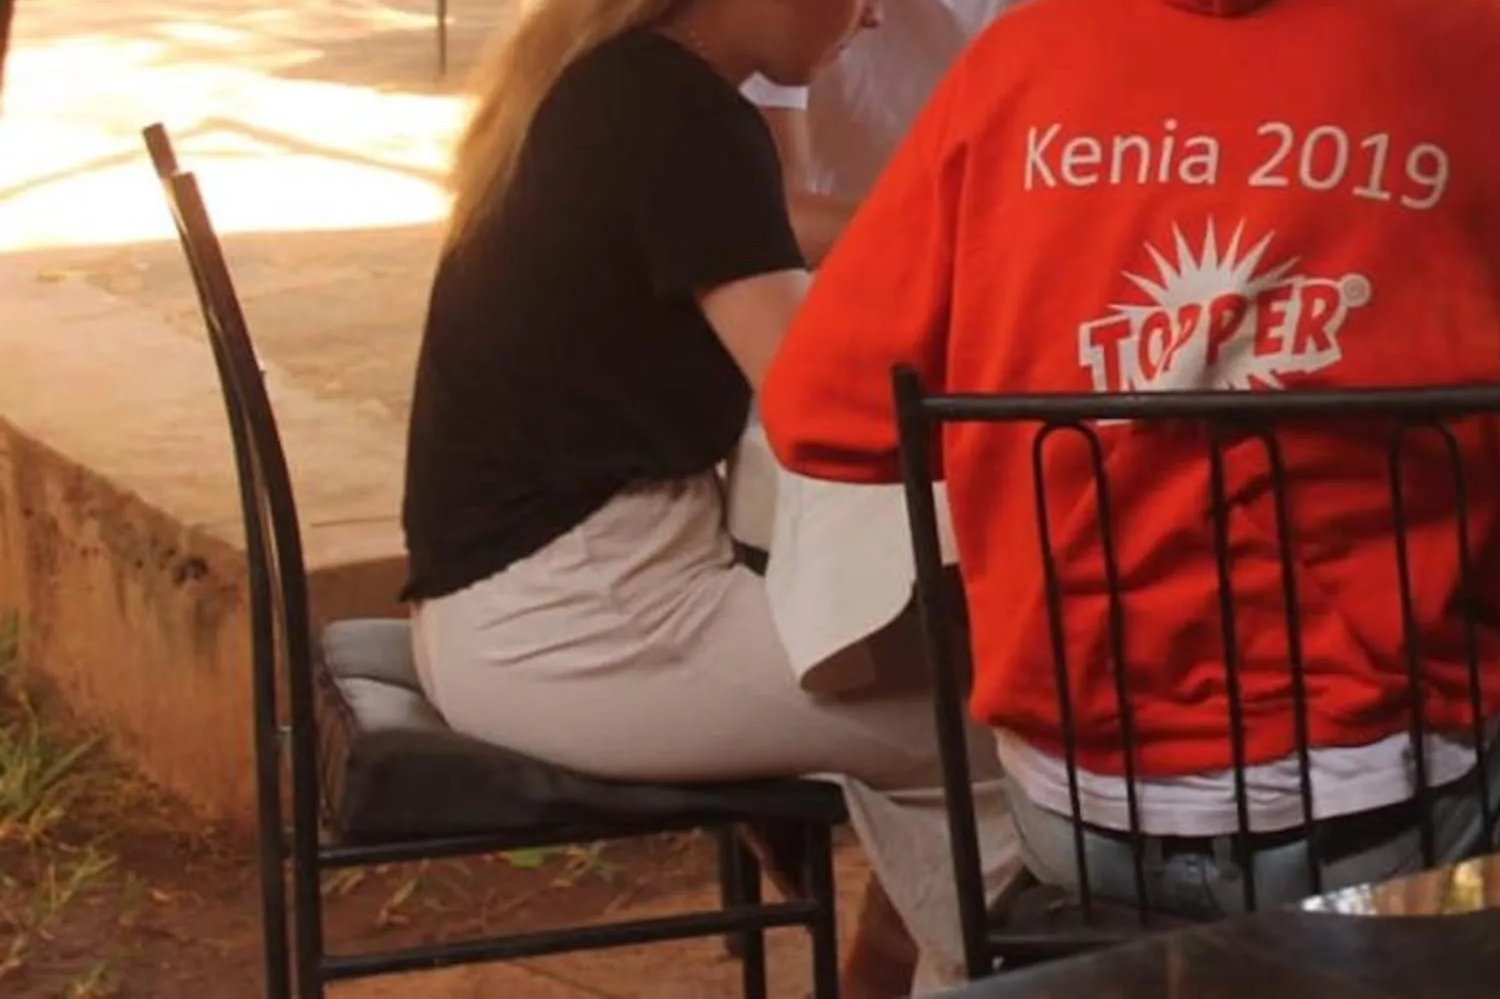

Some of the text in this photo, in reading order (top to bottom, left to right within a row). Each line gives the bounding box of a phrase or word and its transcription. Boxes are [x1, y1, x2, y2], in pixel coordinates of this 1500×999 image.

[1024, 118, 1450, 210] Kenia 2019
[1087, 281, 1343, 392] TOPPER
